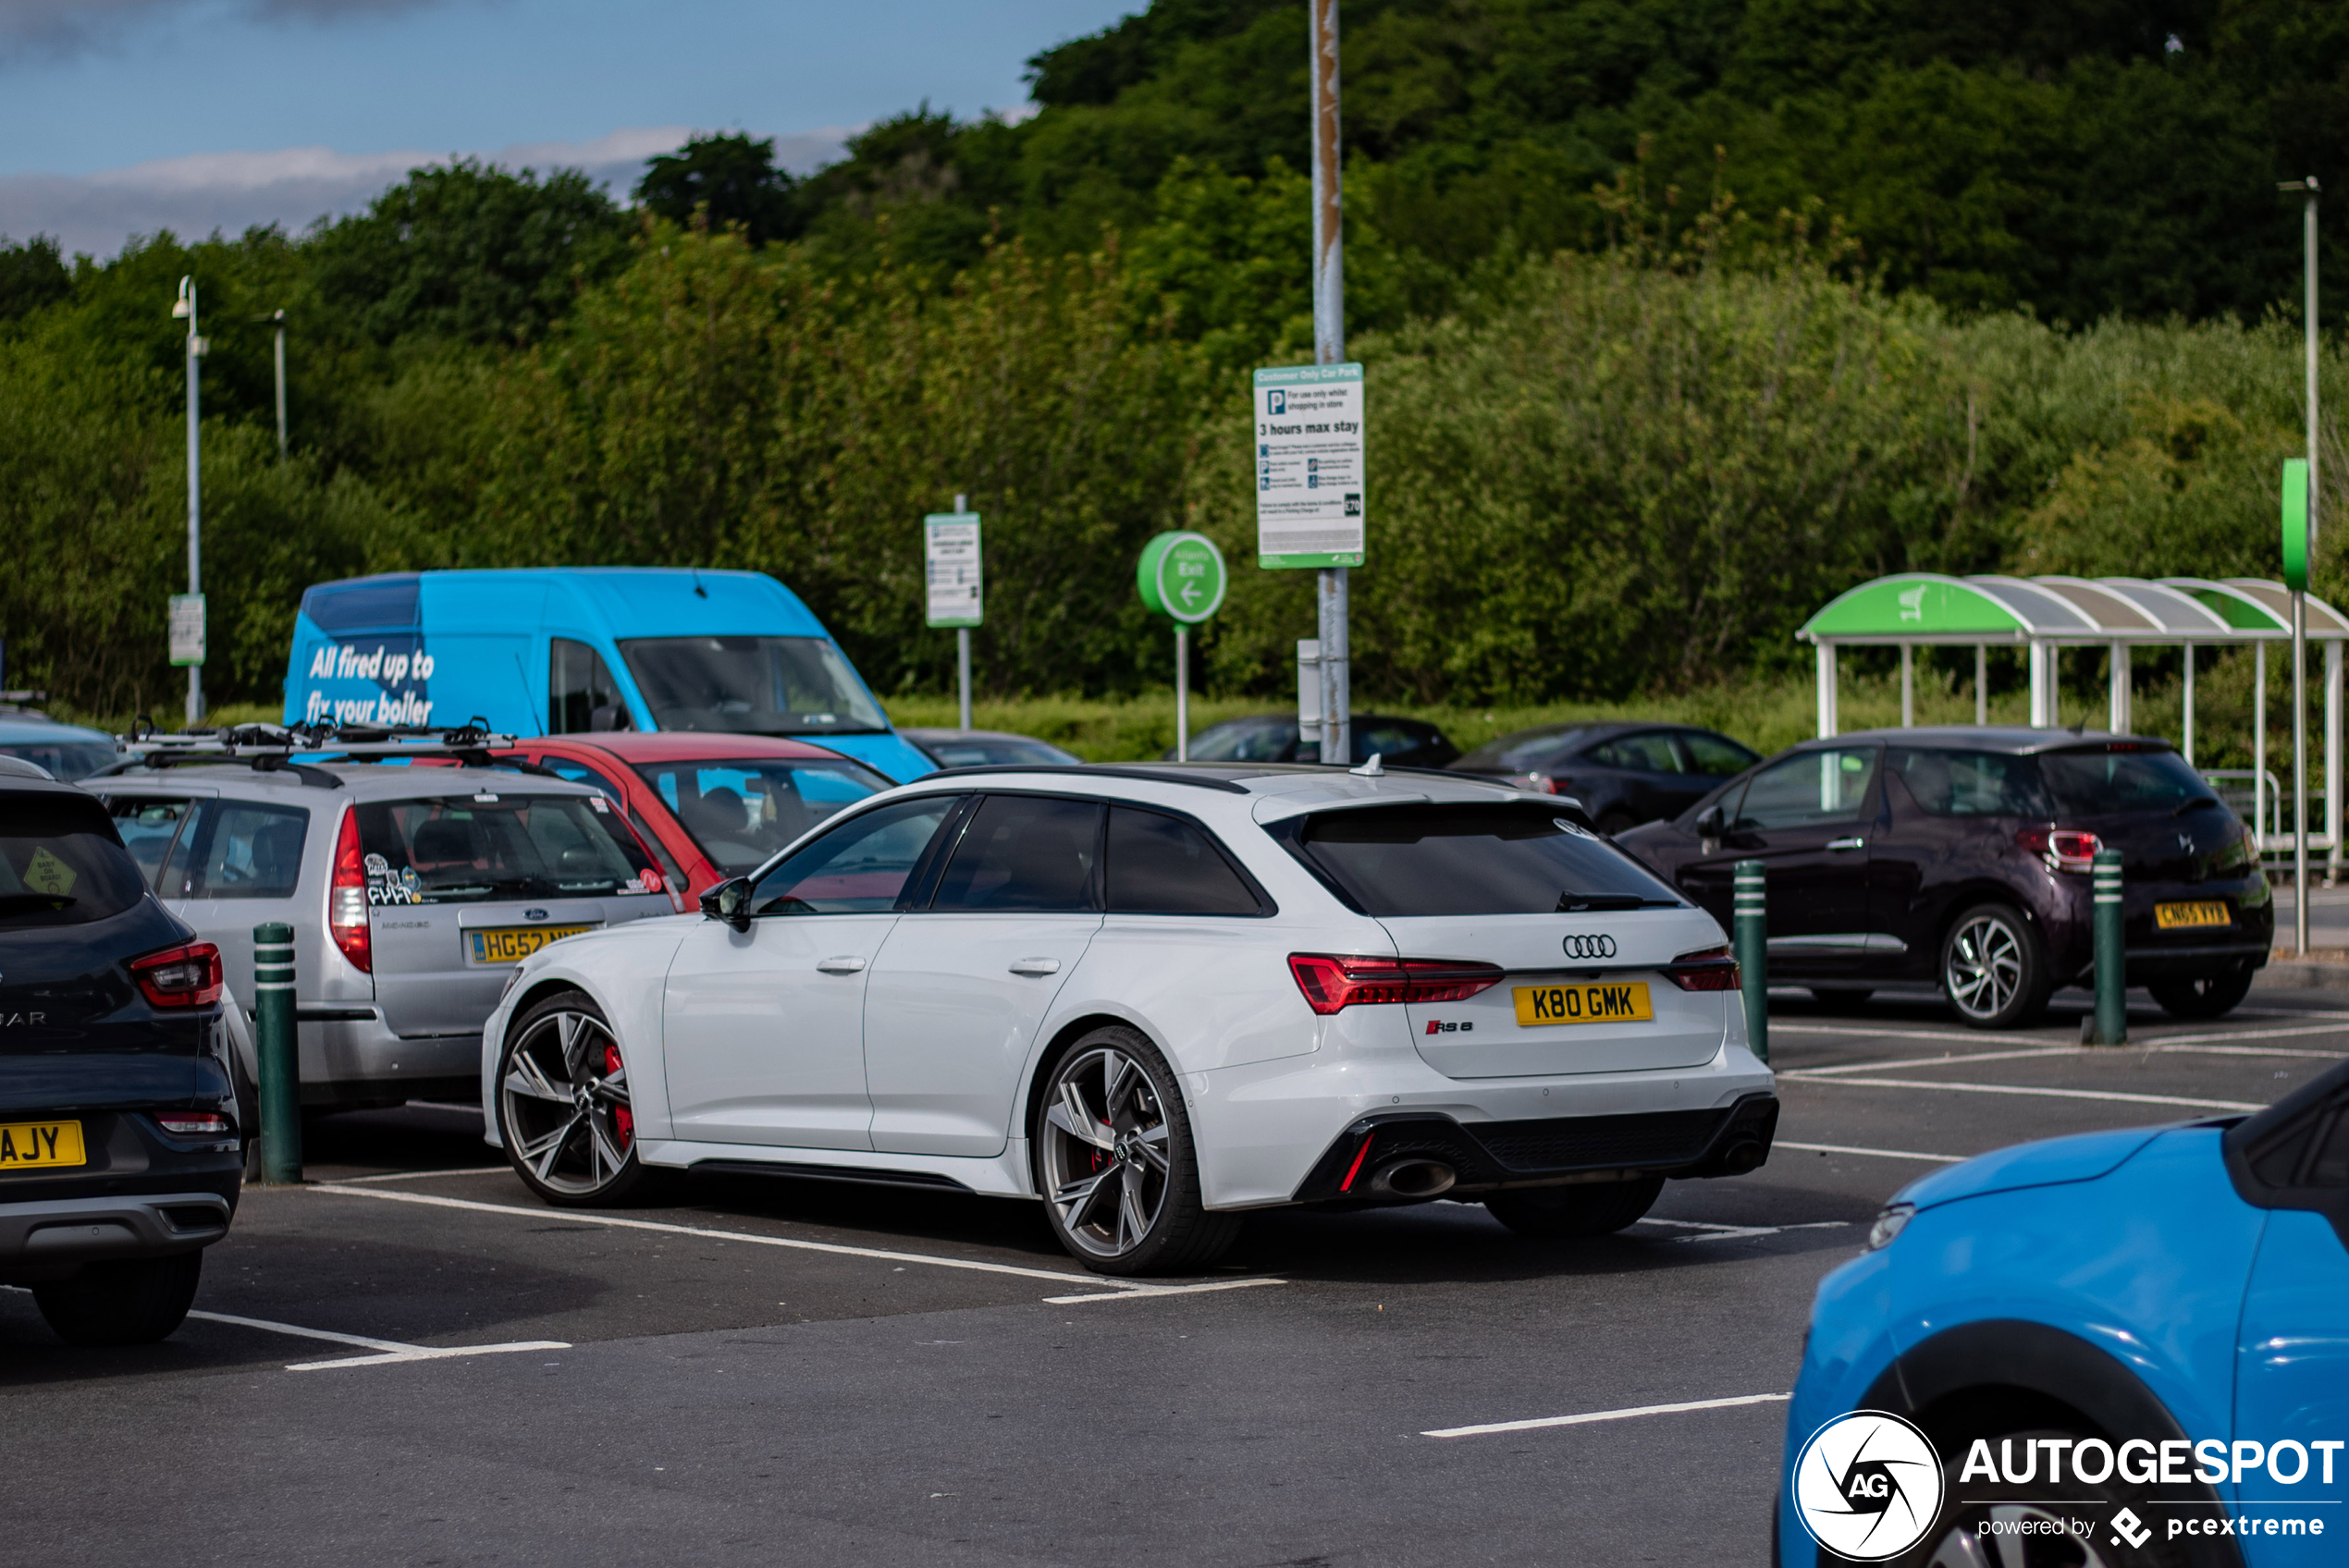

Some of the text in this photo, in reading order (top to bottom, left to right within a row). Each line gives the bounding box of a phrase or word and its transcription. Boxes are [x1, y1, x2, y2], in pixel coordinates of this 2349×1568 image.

[1258, 368, 1359, 382] Customer Only Car Park
[1313, 390, 1326, 398] only
[1288, 401, 1318, 410] shopping
[1260, 421, 1359, 435] 3 hours max stay
[1345, 500, 1360, 512] £70
[1179, 562, 1204, 576] Exit
[309, 644, 435, 688] All fired up to
[306, 691, 433, 727] fix your boiler
[1532, 986, 1634, 1019] K80 GMK
[0, 1011, 46, 1027] AR
